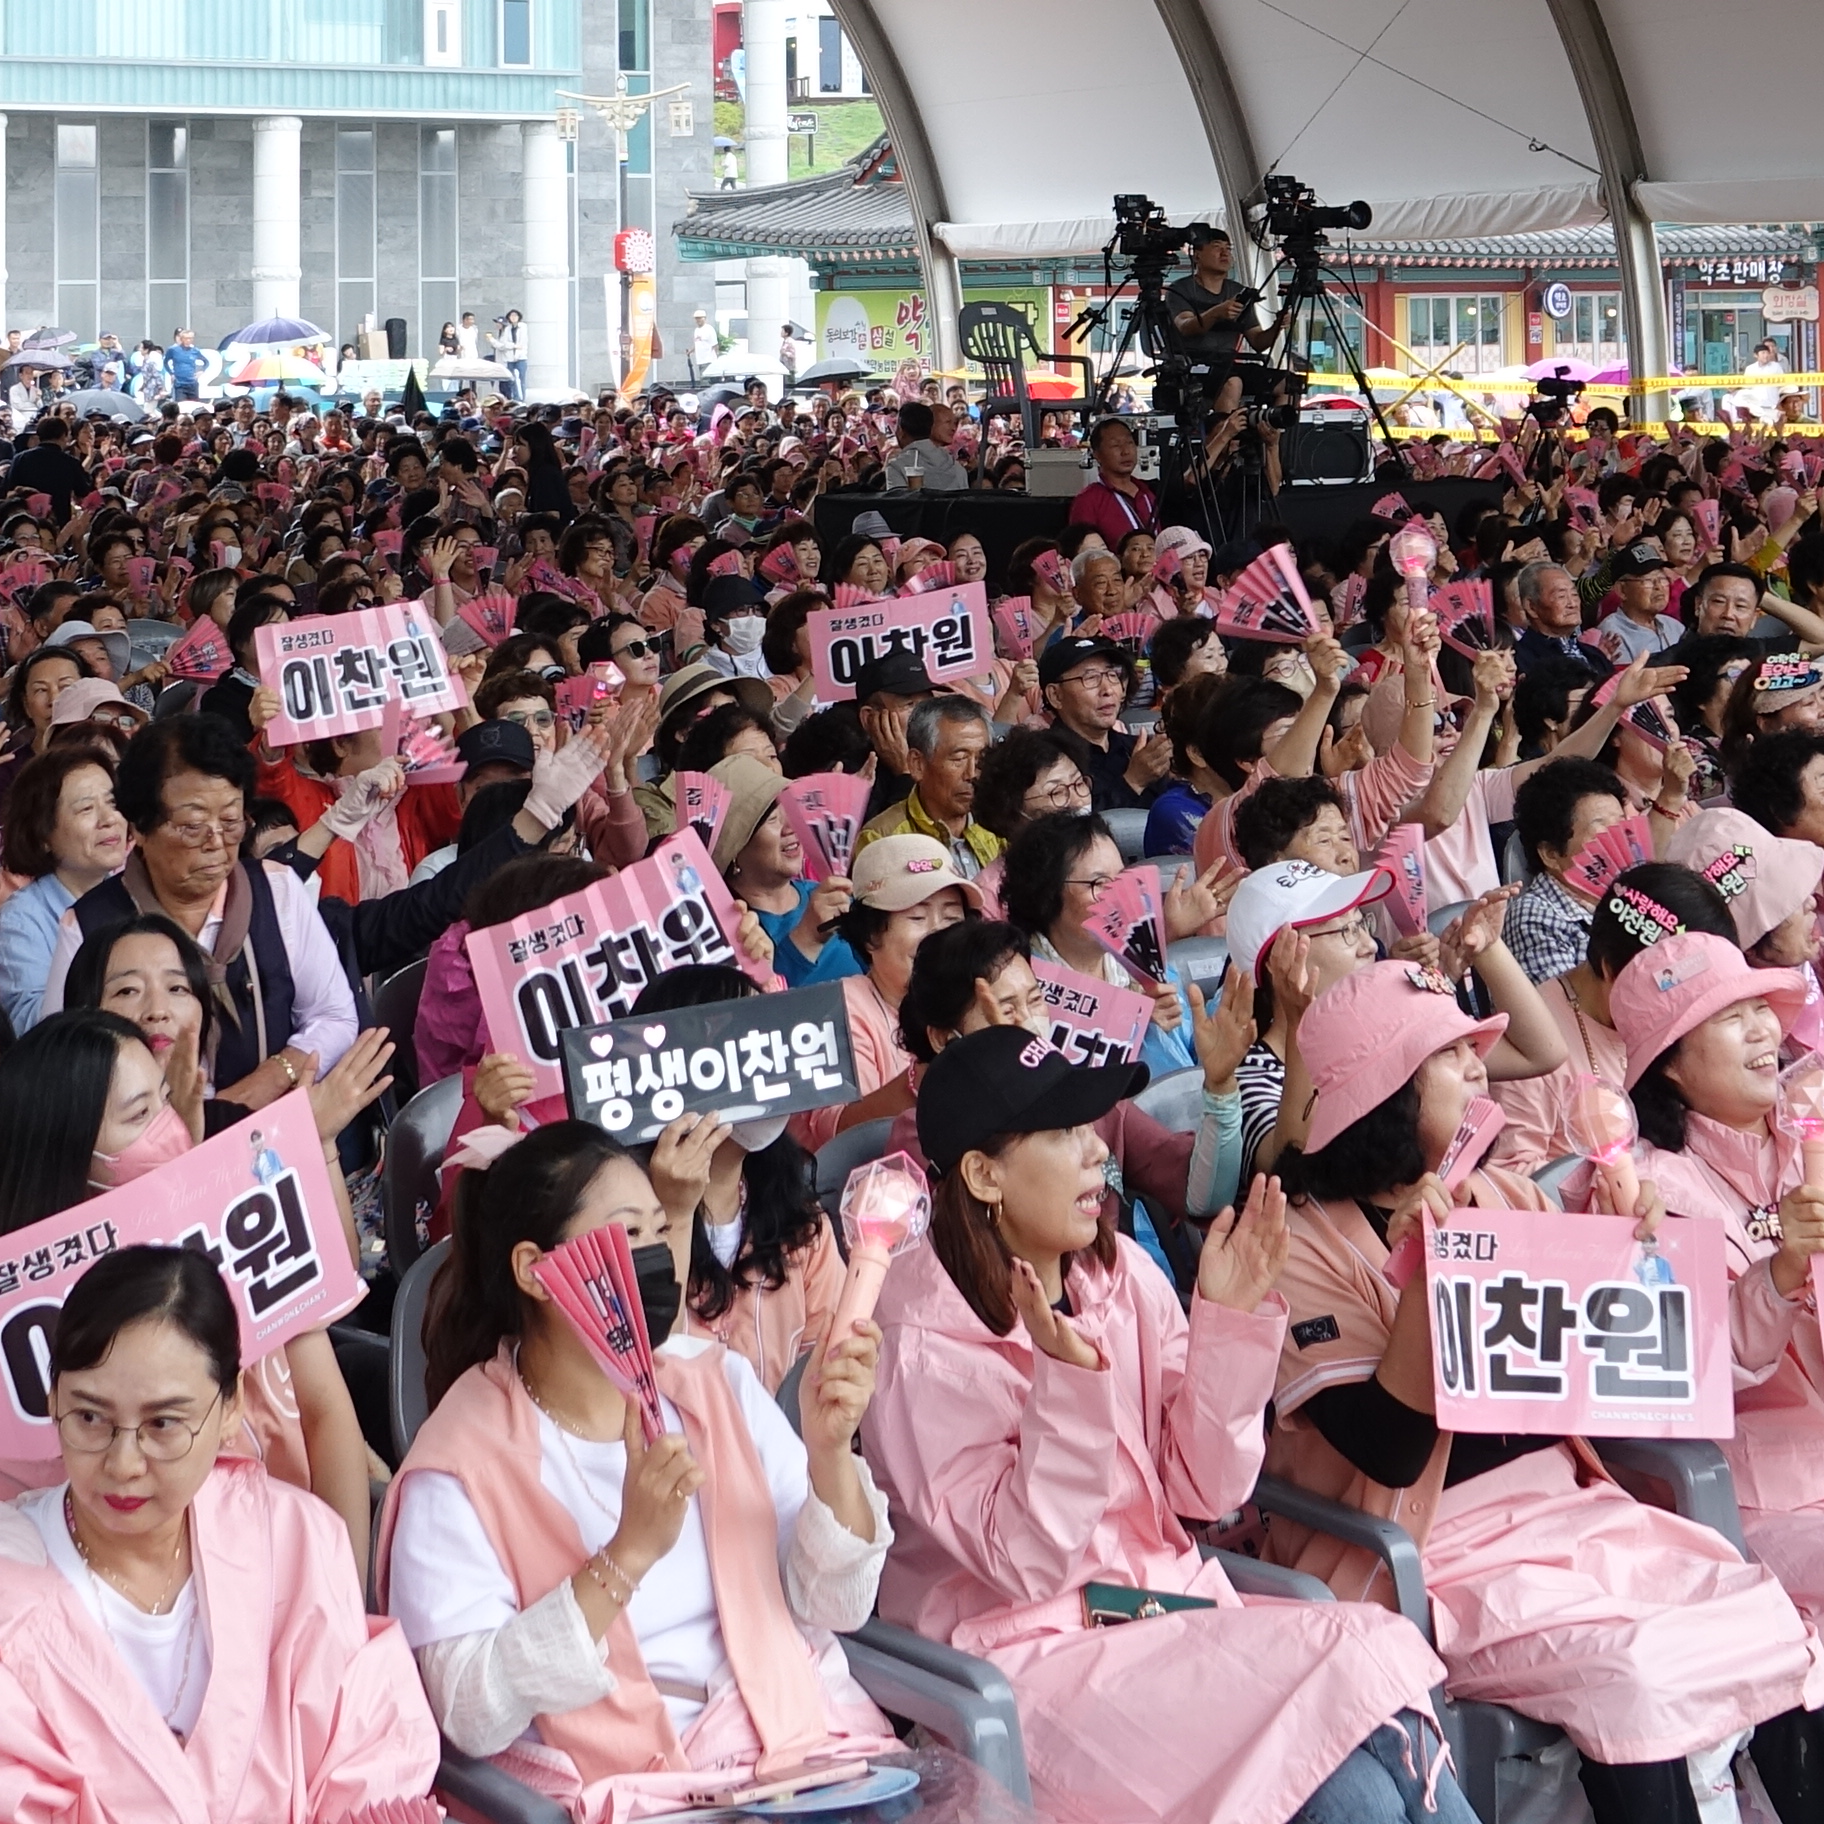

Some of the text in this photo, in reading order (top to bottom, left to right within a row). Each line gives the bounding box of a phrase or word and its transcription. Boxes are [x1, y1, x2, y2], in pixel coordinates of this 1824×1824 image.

[280, 629, 335, 652] 잘생겼다
[830, 613, 885, 633] 잘생겼다
[282, 636, 449, 721] 이찬원
[1609, 897, 1663, 946] 이찬원
[1625, 888, 1679, 933] 사랑해요
[507, 913, 588, 964] 잘생겼다
[1436, 1276, 1691, 1400] 이찬원
